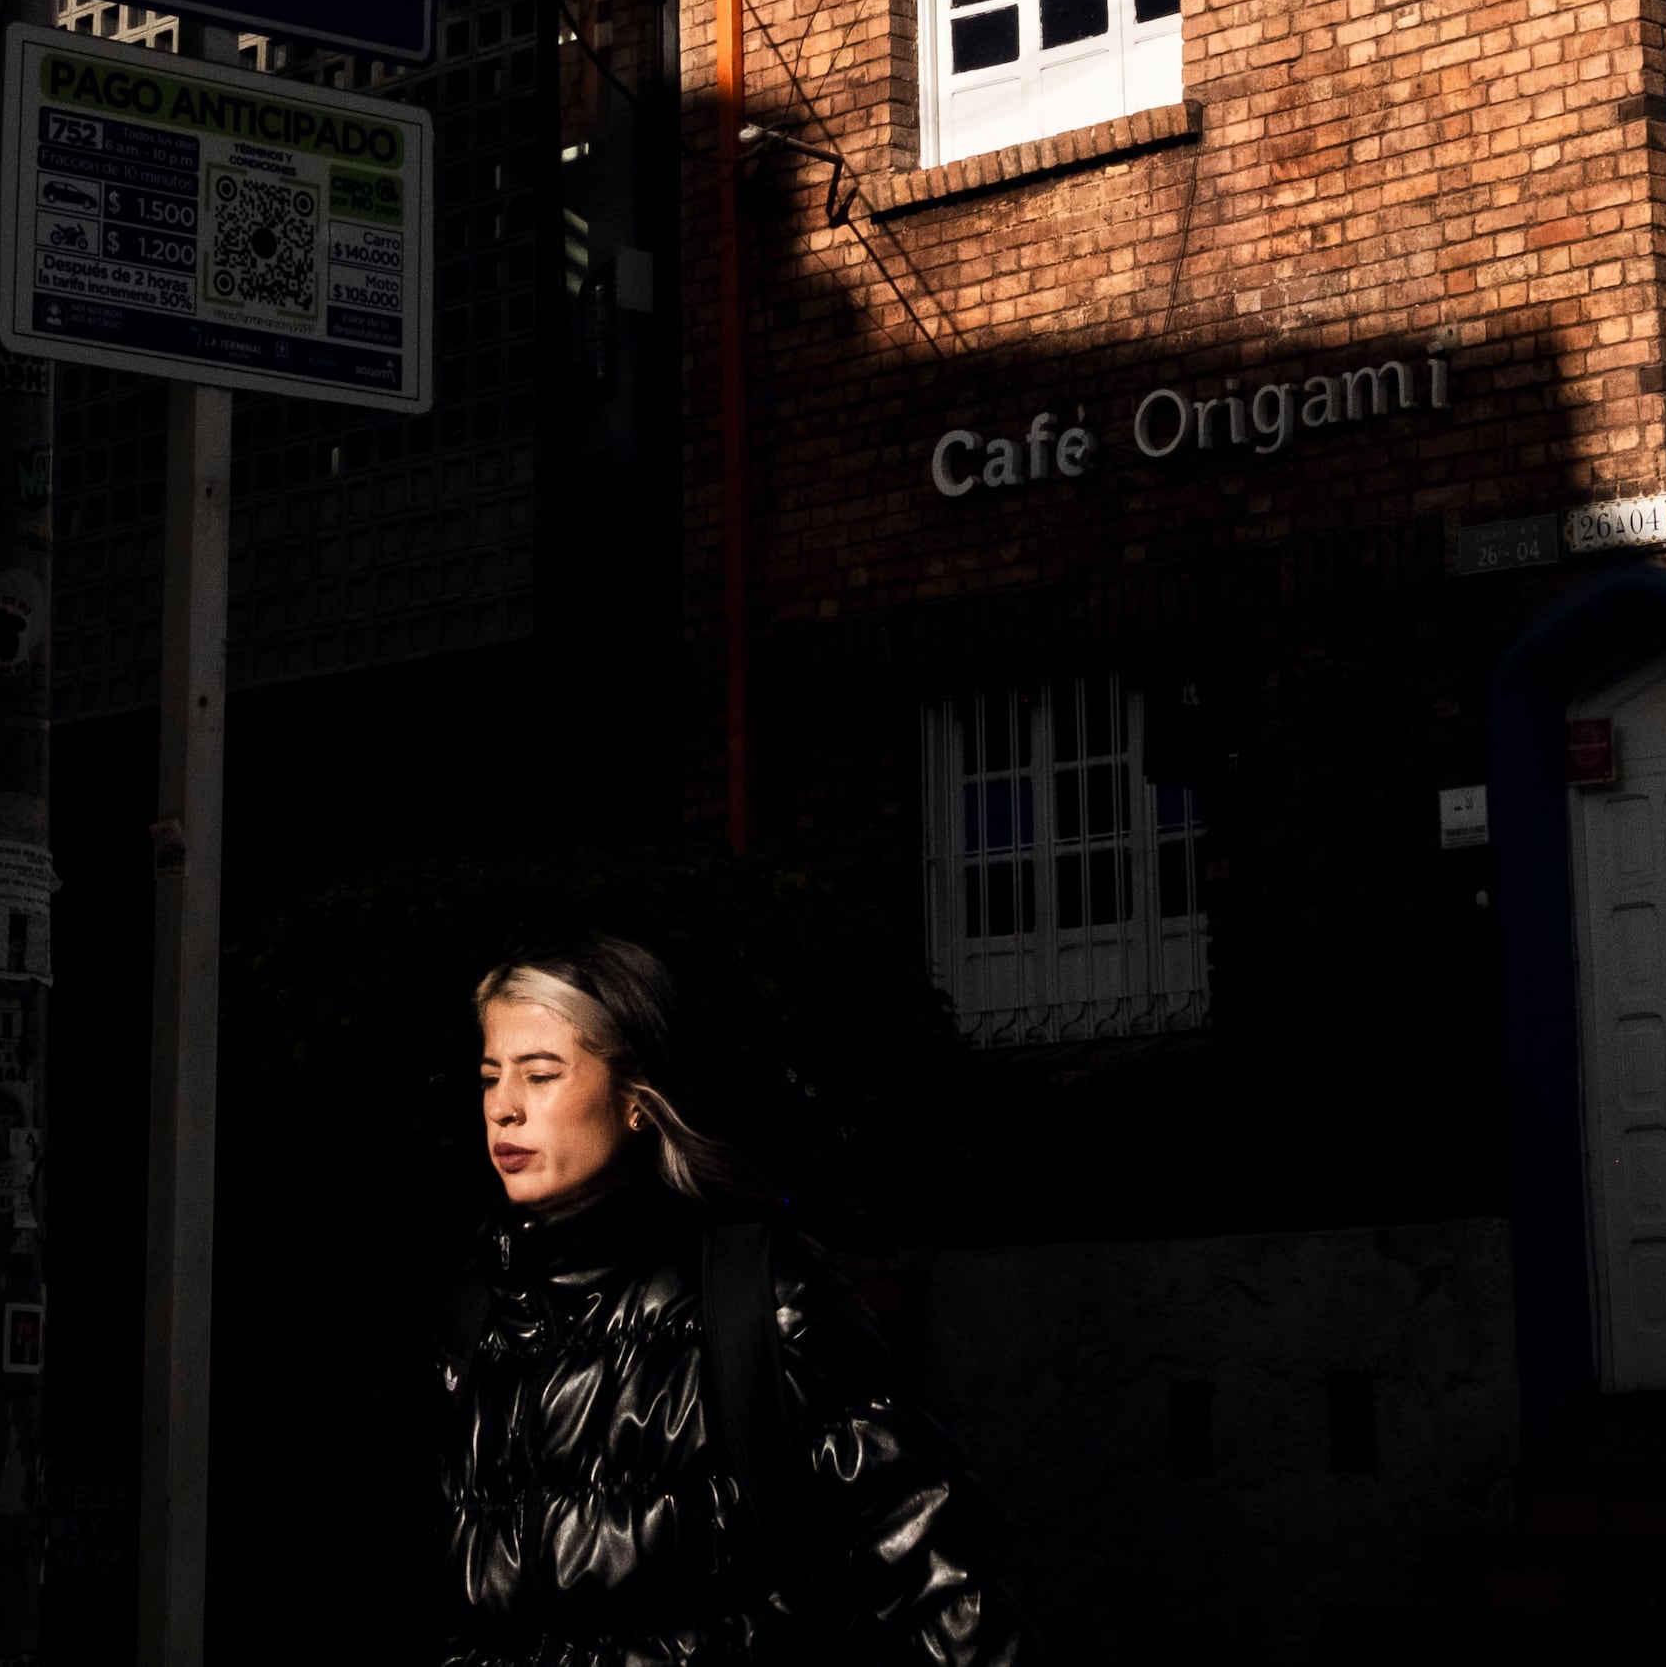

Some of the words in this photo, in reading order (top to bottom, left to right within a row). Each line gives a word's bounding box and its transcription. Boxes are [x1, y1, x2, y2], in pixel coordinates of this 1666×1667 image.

[50, 59, 162, 114] PAGO
[169, 87, 397, 163] ANTICIPADO
[51, 117, 97, 148] 752
[122, 127, 155, 142] Todos
[157, 132, 173, 147] los
[104, 138, 114, 152] 6
[115, 141, 142, 158] a.m.
[152, 148, 168, 163] 10
[169, 153, 195, 169] p.m.
[285, 153, 294, 163] Y
[41, 148, 100, 171] Fracción
[102, 160, 120, 176] de
[123, 164, 138, 180] 10
[140, 168, 195, 191] minutos
[229, 154, 297, 177] CONDICIONES
[136, 197, 195, 228] 1.500
[352, 196, 374, 211] NO
[137, 236, 195, 266] 1.200
[363, 231, 401, 251] Carro
[44, 254, 108, 280] Después
[112, 268, 131, 283] de
[134, 271, 145, 286] 2
[148, 273, 188, 294] horas
[365, 274, 399, 292] Moto
[38, 269, 50, 284] la
[53, 273, 85, 291] tarifa
[88, 279, 157, 305] incrementa
[160, 292, 192, 310] 50%
[341, 312, 366, 325] Valor
[368, 316, 380, 327] de
[381, 319, 390, 330] la
[204, 335, 217, 348] LA
[220, 337, 264, 356] TERMINAL
[332, 324, 399, 344] desinstalación
[932, 403, 1095, 497] Café
[1134, 341, 1451, 458] Origami
[1517, 539, 1541, 562] 04
